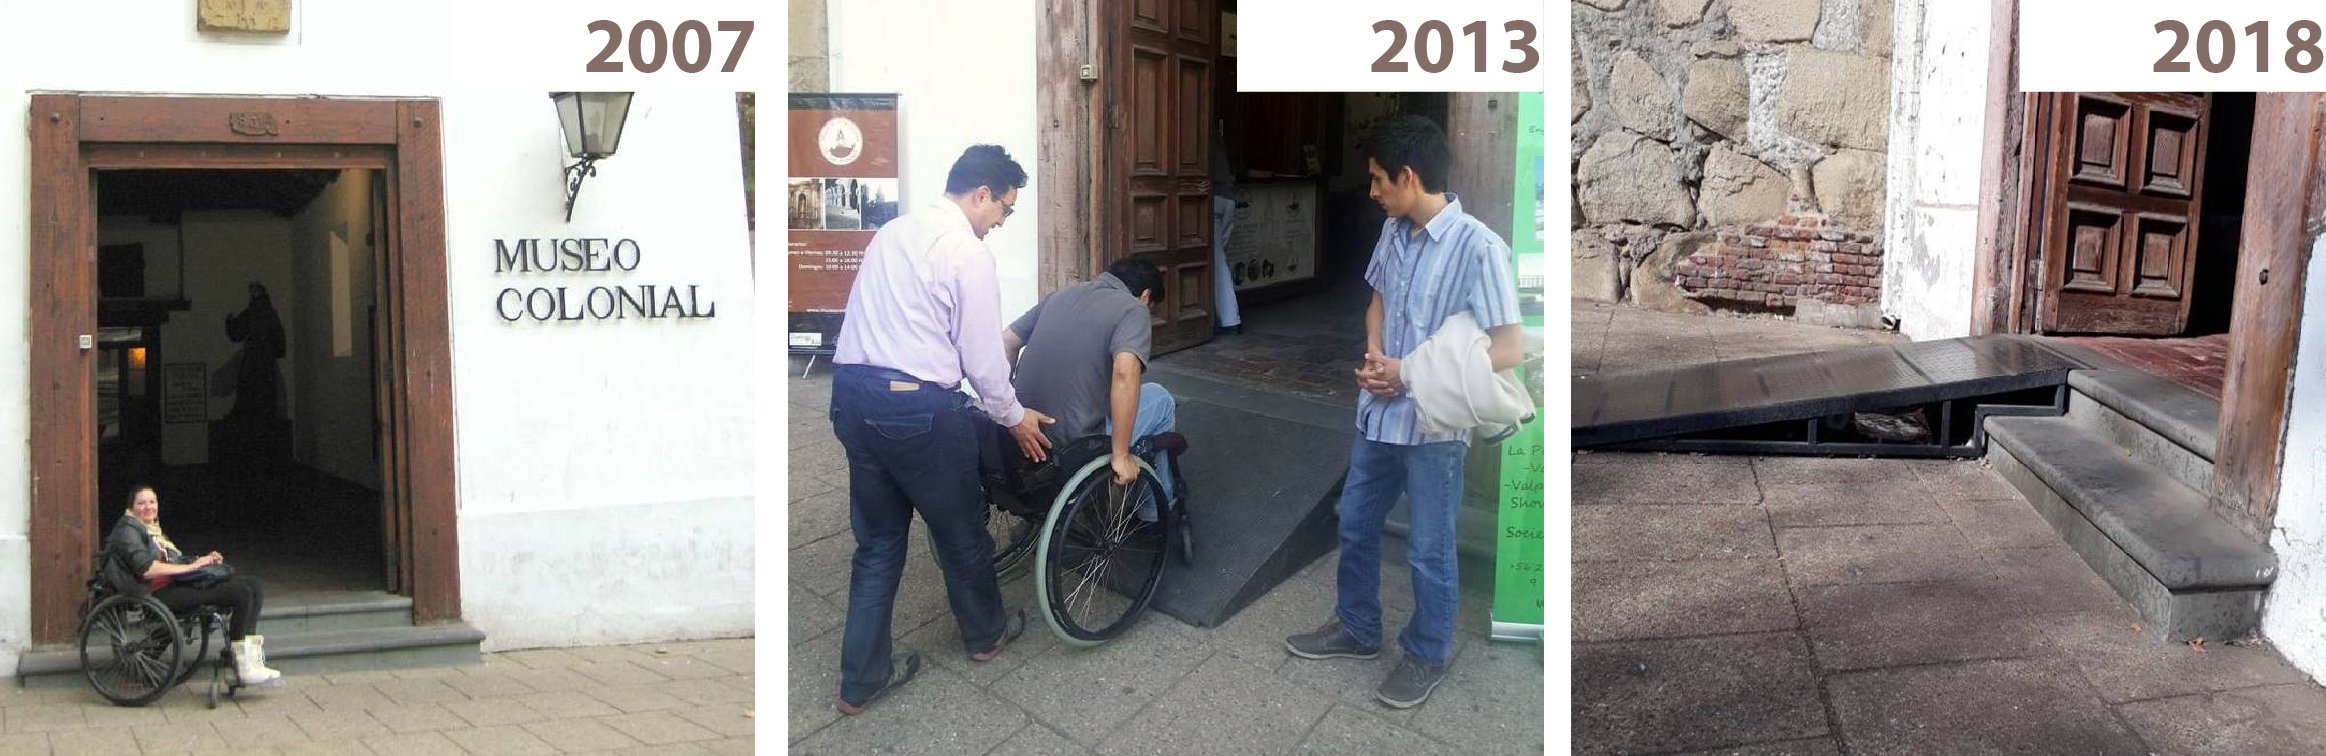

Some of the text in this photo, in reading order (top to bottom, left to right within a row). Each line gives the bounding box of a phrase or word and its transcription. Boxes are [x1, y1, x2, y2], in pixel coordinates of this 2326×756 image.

[494, 238, 641, 273] MUSEO
[496, 285, 716, 322] COLONIAL
[1507, 445, 1525, 456] La
